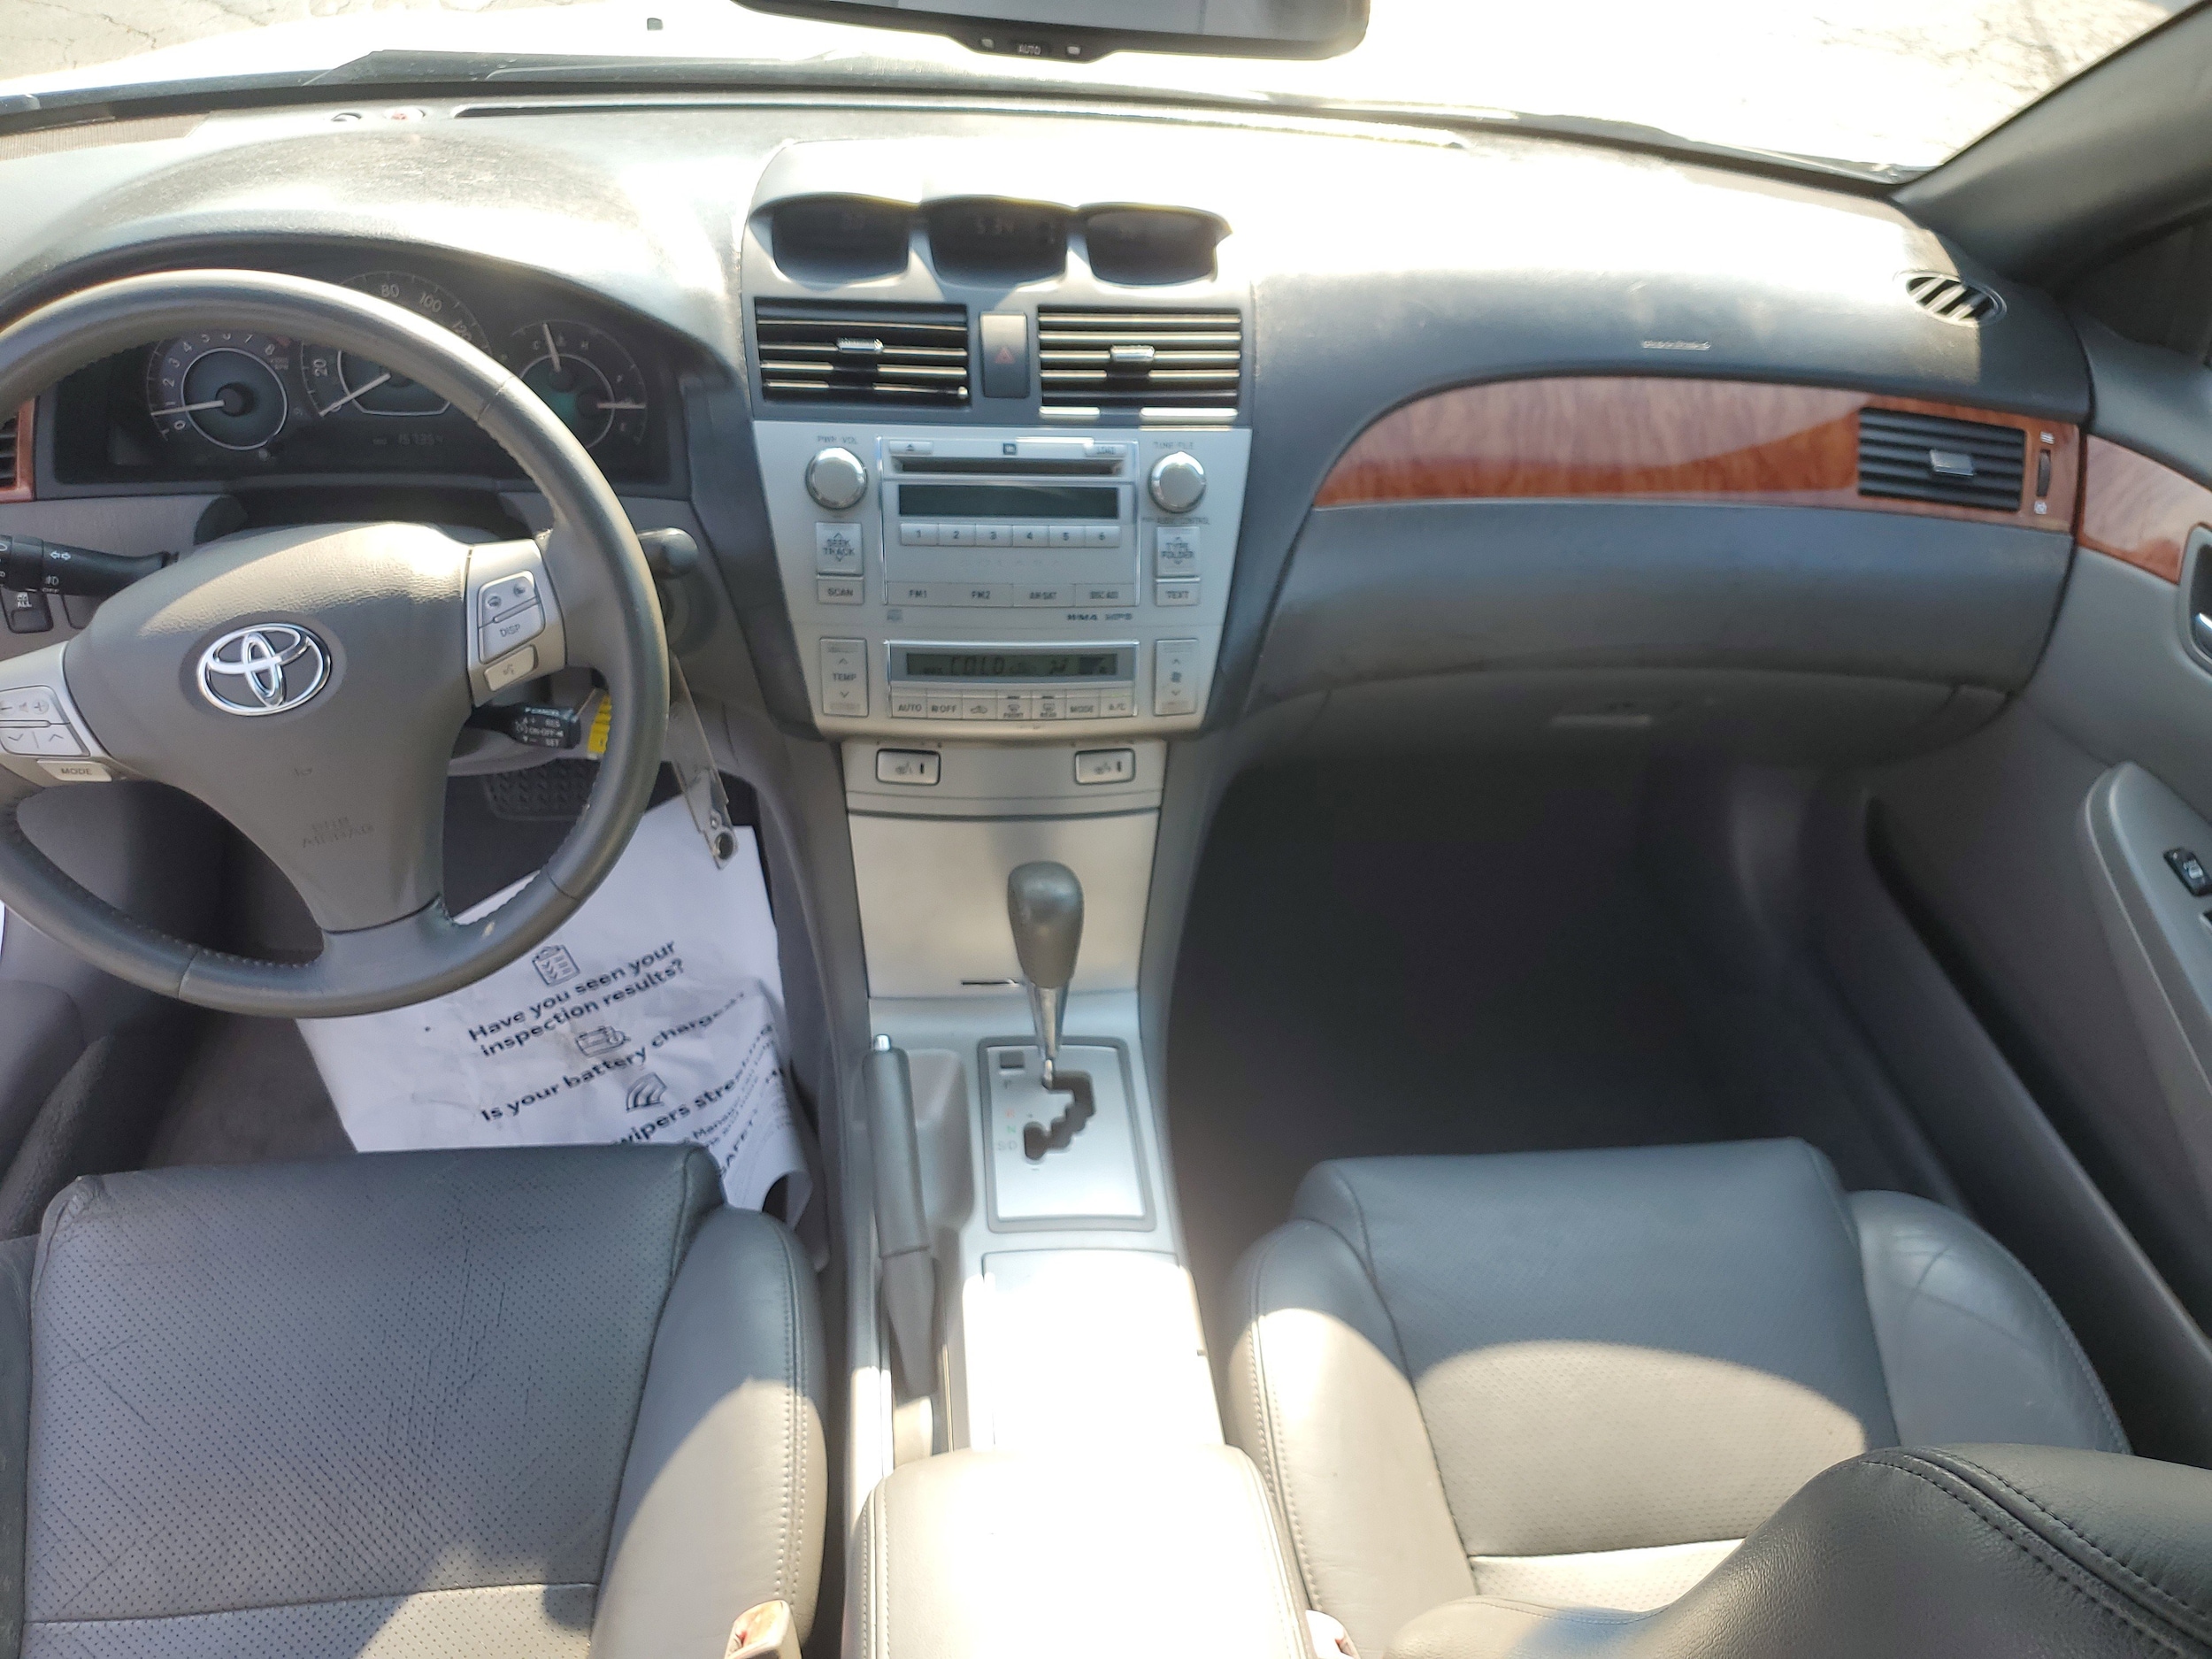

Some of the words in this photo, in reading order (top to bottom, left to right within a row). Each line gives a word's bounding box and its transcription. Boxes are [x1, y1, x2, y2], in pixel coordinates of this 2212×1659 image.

[380, 284, 400, 297] 80
[419, 292, 442, 312] 100
[182, 342, 192, 352] 4
[265, 343, 275, 356] 8
[168, 357, 180, 368] 3
[312, 358, 328, 378] 20
[162, 378, 175, 388] 2
[173, 419, 187, 431] 0
[916, 529, 922, 538] 1
[953, 530, 961, 539] 2
[989, 531, 998, 541] 3
[1026, 532, 1033, 541] 4
[1063, 532, 1071, 541] 5
[1098, 532, 1106, 541] 6
[827, 588, 854, 597] SCAN
[909, 589, 928, 599] FM1
[972, 590, 991, 600] FM2
[499, 623, 521, 637] DISP
[468, 1010, 526, 1042] Have
[529, 990, 571, 1019] you
[575, 967, 626, 995] seen
[627, 941, 676, 977] your
[480, 1000, 600, 1057] inspection
[603, 956, 685, 1007] results?
[480, 1106, 504, 1123] Is
[506, 1082, 561, 1118] your
[562, 1046, 648, 1089] battery
